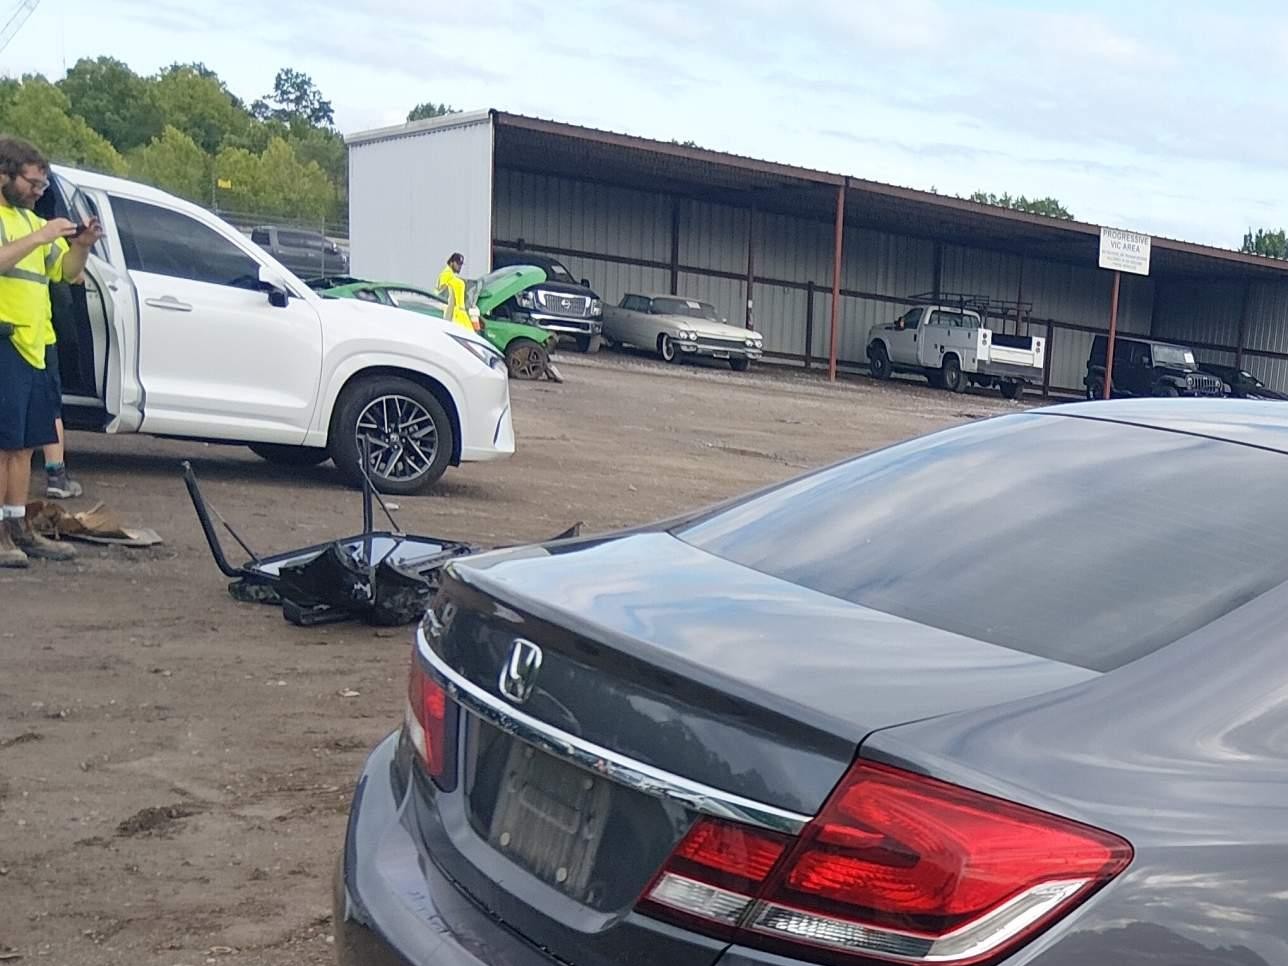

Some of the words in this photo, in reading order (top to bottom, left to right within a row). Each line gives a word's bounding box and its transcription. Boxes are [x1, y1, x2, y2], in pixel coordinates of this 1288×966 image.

[1103, 229, 1149, 245] PROGRESSIVE
[1110, 240, 1121, 250] VIC
[1122, 243, 1141, 253] AREA
